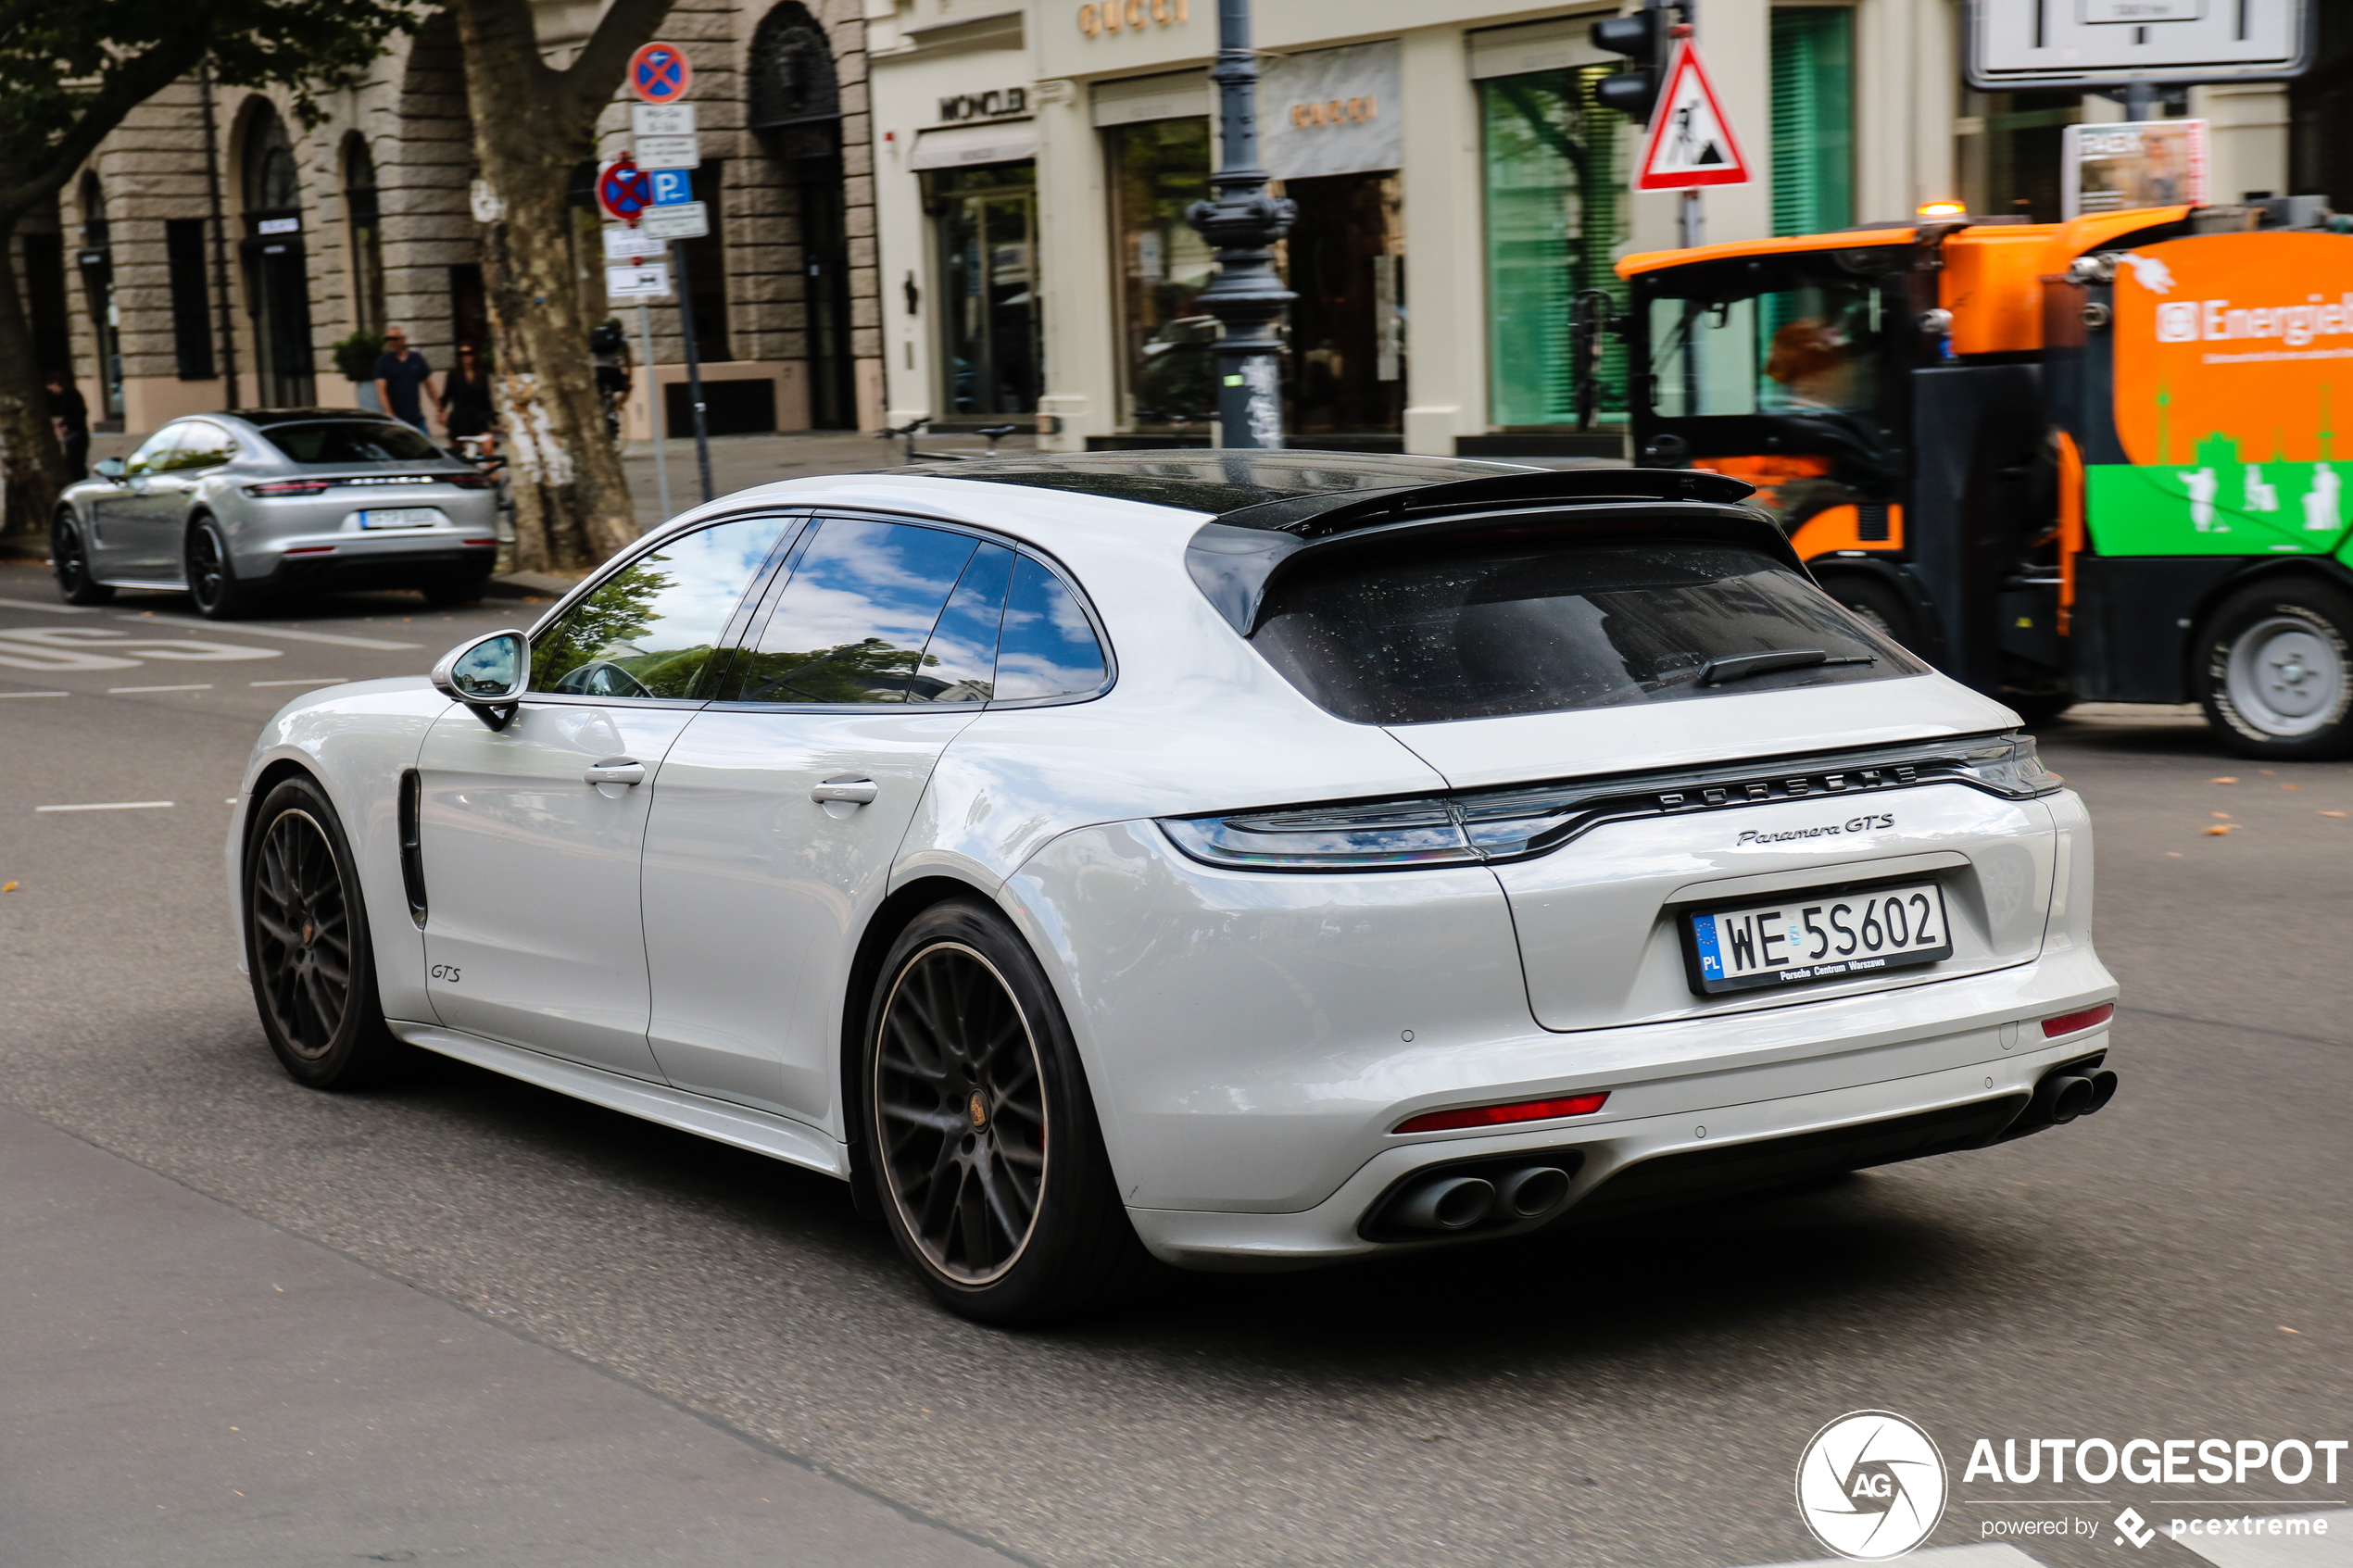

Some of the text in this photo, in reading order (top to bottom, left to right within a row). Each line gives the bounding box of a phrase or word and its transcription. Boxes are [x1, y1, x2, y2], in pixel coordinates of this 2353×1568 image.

[1078, 0, 1189, 39] GUCCI
[1290, 95, 1378, 129] GUCCI
[655, 173, 678, 201] P
[1658, 767, 1917, 811] PORSCHE
[1736, 812, 1895, 847] Panamera GTS
[1726, 893, 1937, 972] WE 5S602
[431, 964, 461, 983] GTS
[1703, 955, 1720, 972] PL
[1780, 957, 1886, 982] Porsche Centrum Warszawa
